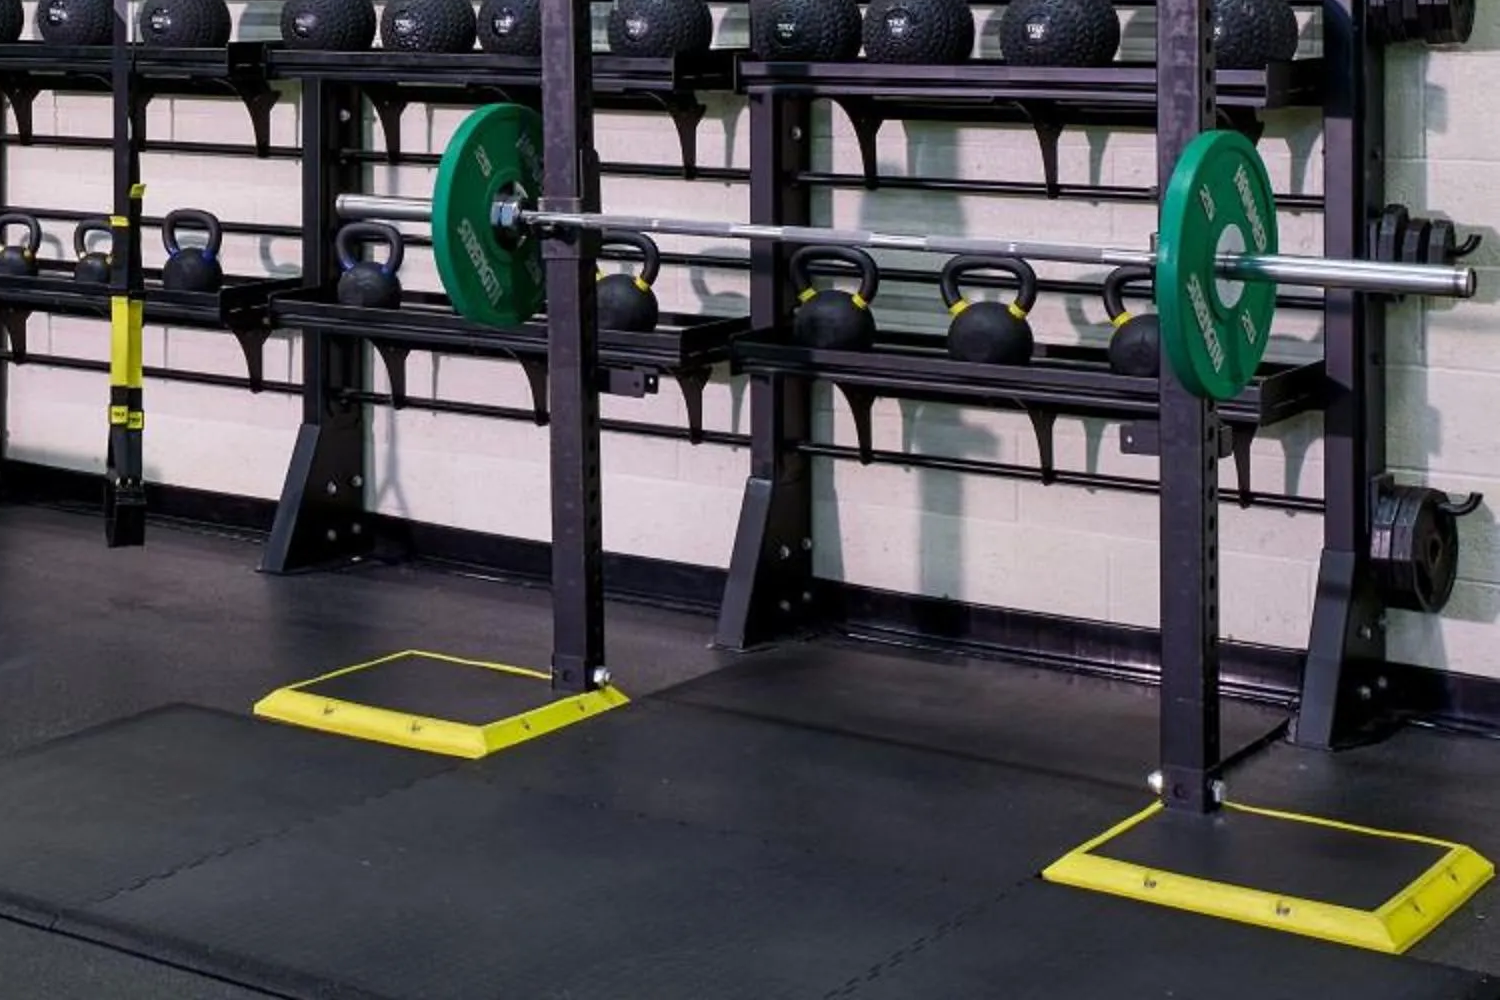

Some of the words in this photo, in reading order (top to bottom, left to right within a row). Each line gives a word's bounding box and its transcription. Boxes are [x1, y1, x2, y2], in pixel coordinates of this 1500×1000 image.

[1199, 183, 1216, 222] 25
[457, 216, 504, 307] STRENGTH
[1186, 273, 1226, 375] STRENGTH
[1241, 308, 1257, 345] 25
